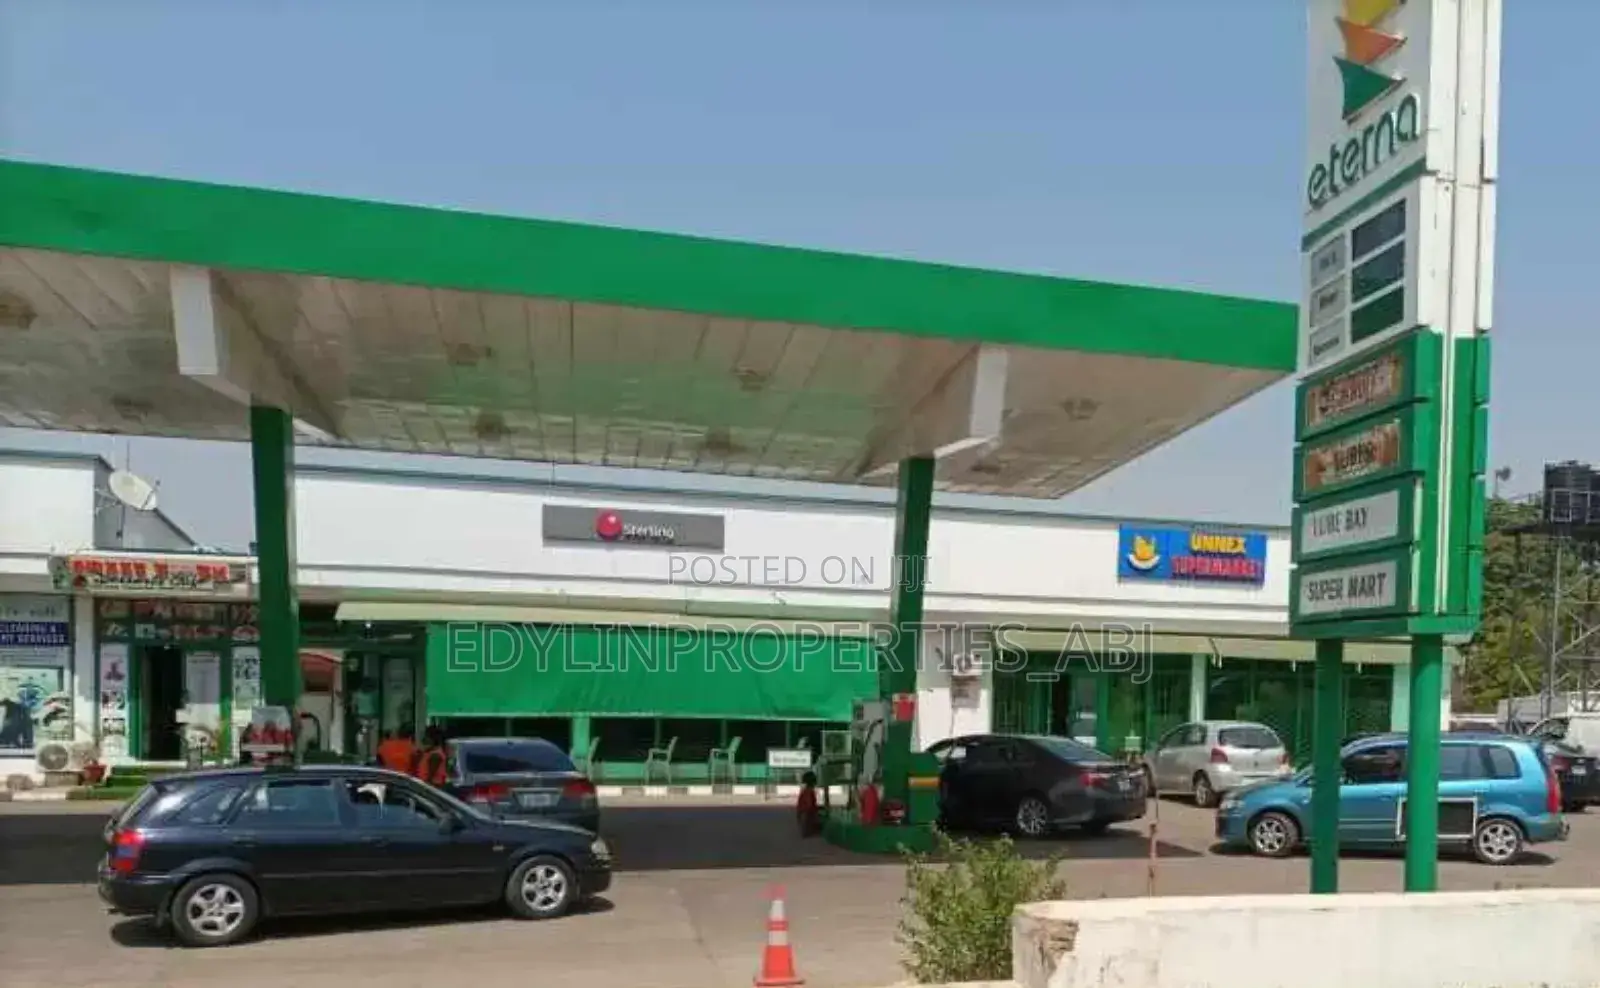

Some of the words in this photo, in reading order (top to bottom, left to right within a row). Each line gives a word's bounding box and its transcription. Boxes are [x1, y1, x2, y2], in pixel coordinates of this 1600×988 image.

[1307, 93, 1418, 207] eterna
[1306, 578, 1343, 602] SUPER
[1347, 572, 1387, 599] MART
